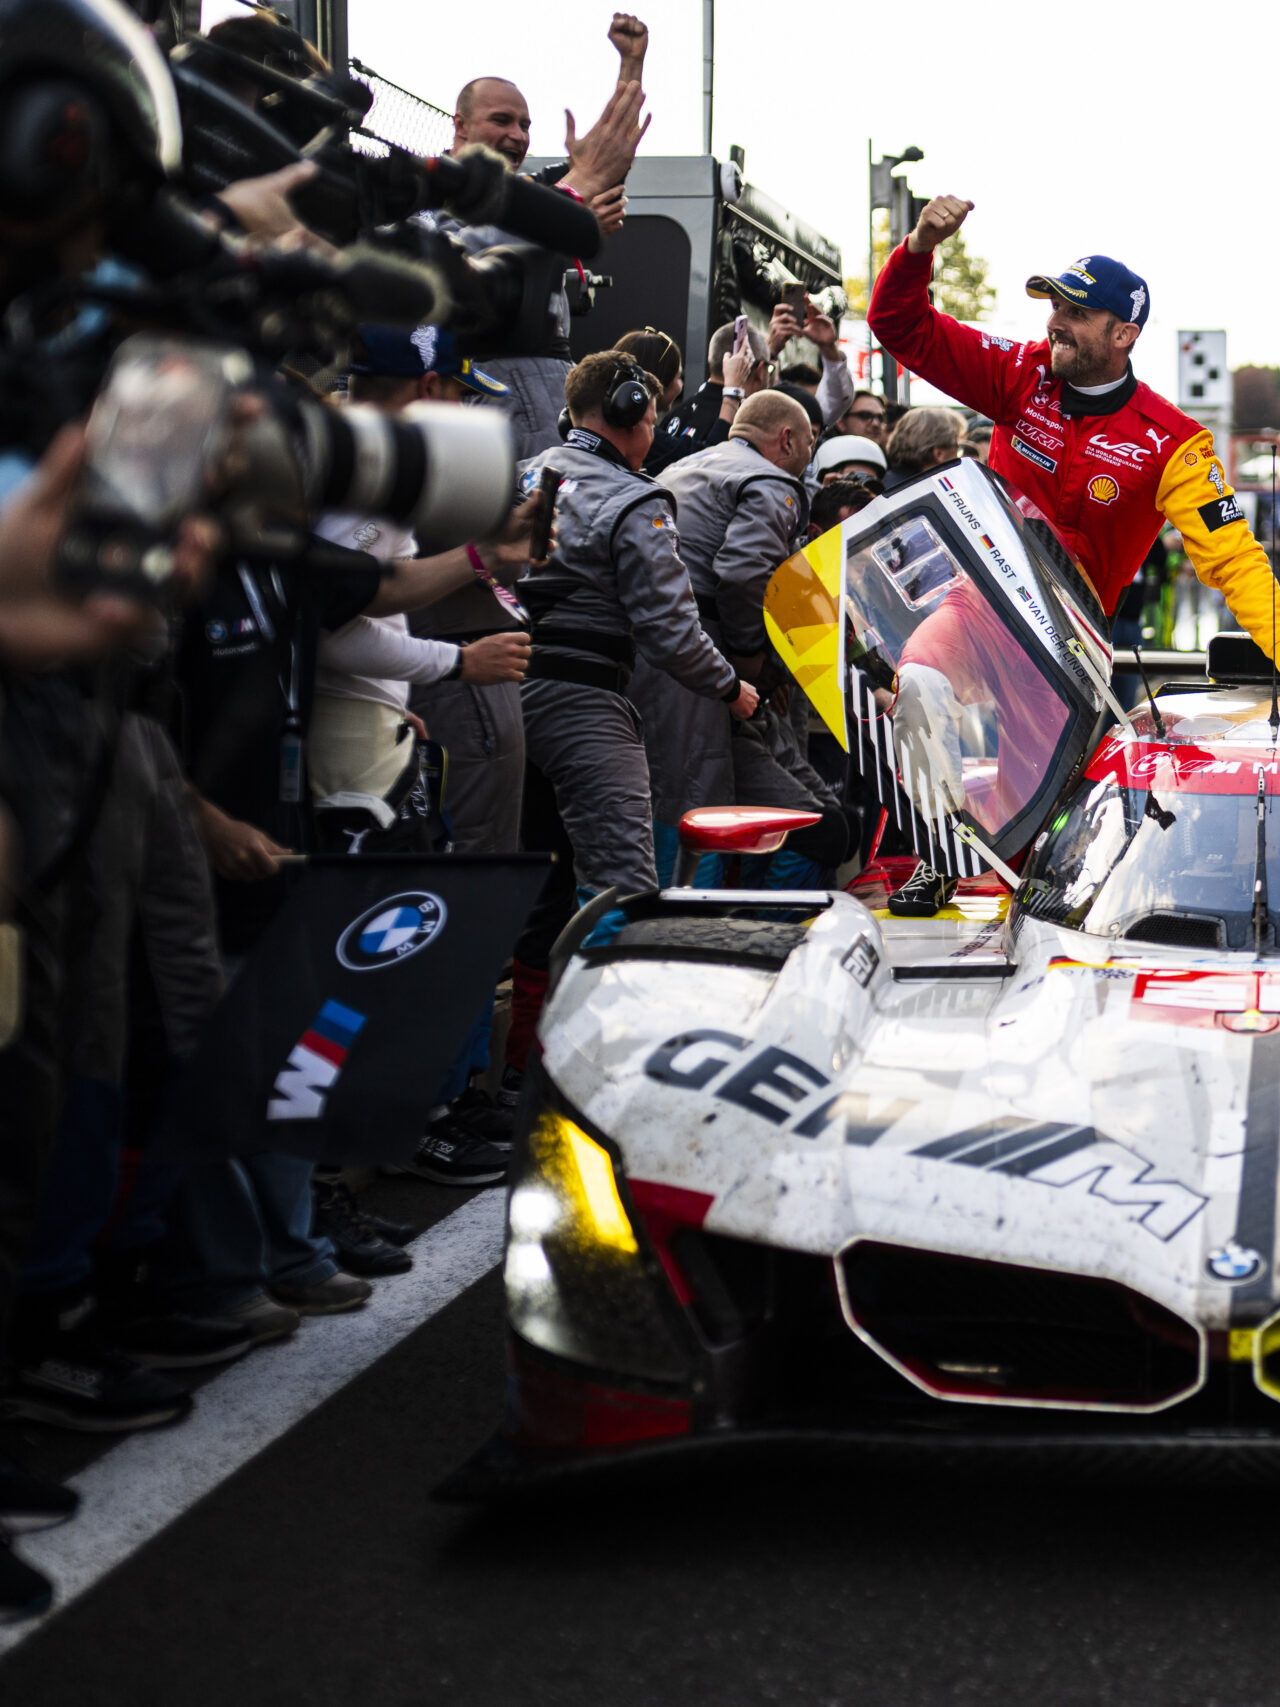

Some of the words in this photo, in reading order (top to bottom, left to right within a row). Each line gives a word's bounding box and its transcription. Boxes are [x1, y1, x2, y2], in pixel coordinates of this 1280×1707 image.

[1024, 408, 1065, 433] Motorsport
[1015, 419, 1065, 450] WRT
[1089, 433, 1152, 462] WEC
[1021, 446, 1052, 468] MICHELIN
[1084, 449, 1121, 467] CHAMPIONSHIP
[1095, 447, 1113, 459] WORLD
[1112, 454, 1143, 471] ENDURANCE
[948, 491, 982, 531] FRIJNS
[990, 548, 1017, 580] RAST
[1028, 600, 1048, 626] VAN
[1043, 624, 1065, 652] DER
[1062, 649, 1093, 686] LINDE
[643, 1028, 920, 1148] GEN
